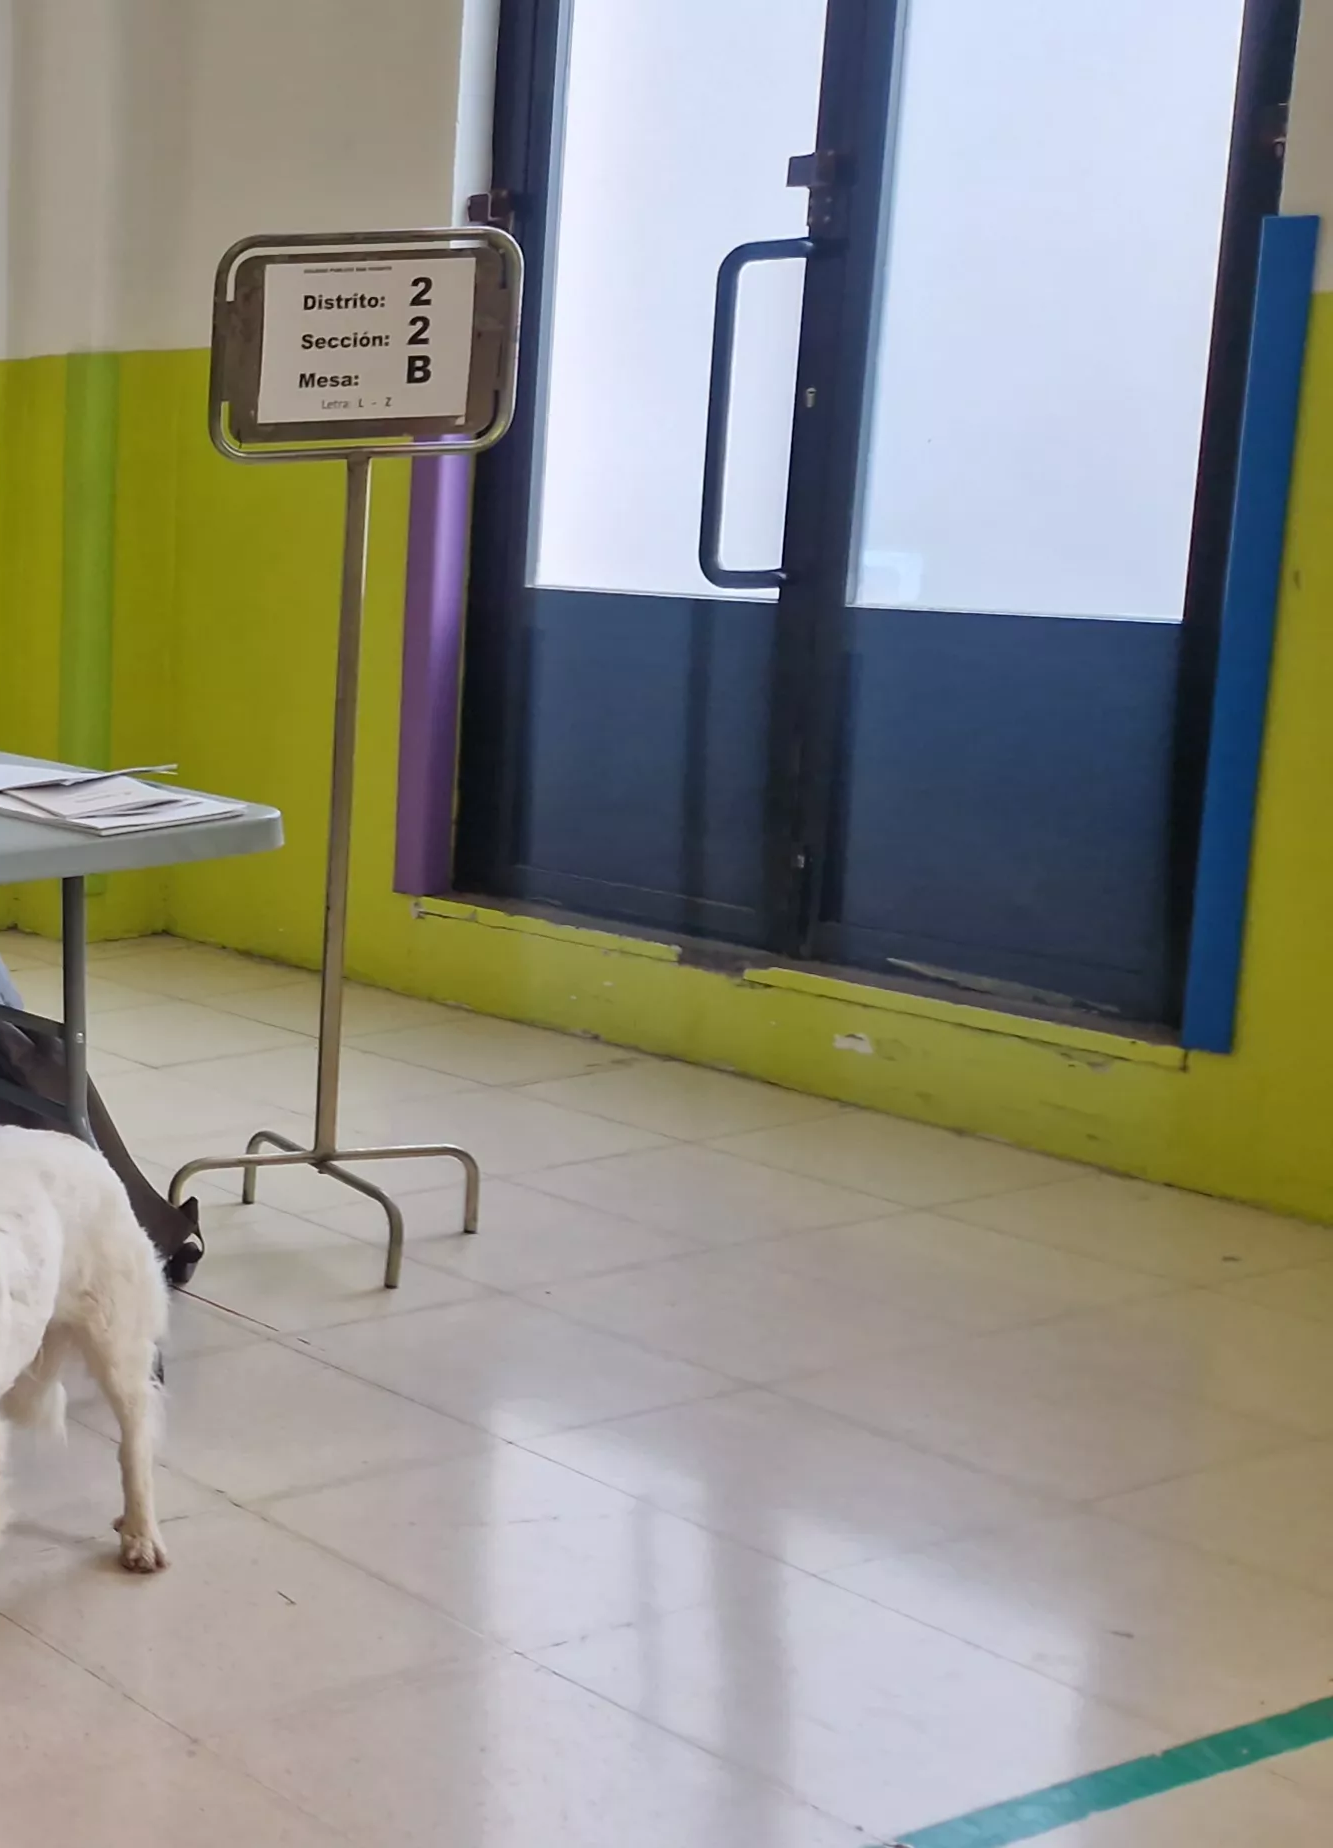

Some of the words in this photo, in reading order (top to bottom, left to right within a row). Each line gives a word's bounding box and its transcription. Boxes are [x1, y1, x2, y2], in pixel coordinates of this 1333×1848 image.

[303, 293, 386, 311] Distrito:
[409, 276, 433, 307] 2
[301, 331, 390, 350] Sección:
[406, 315, 431, 346] 2
[298, 372, 359, 388] Mesa:
[406, 355, 432, 384] B
